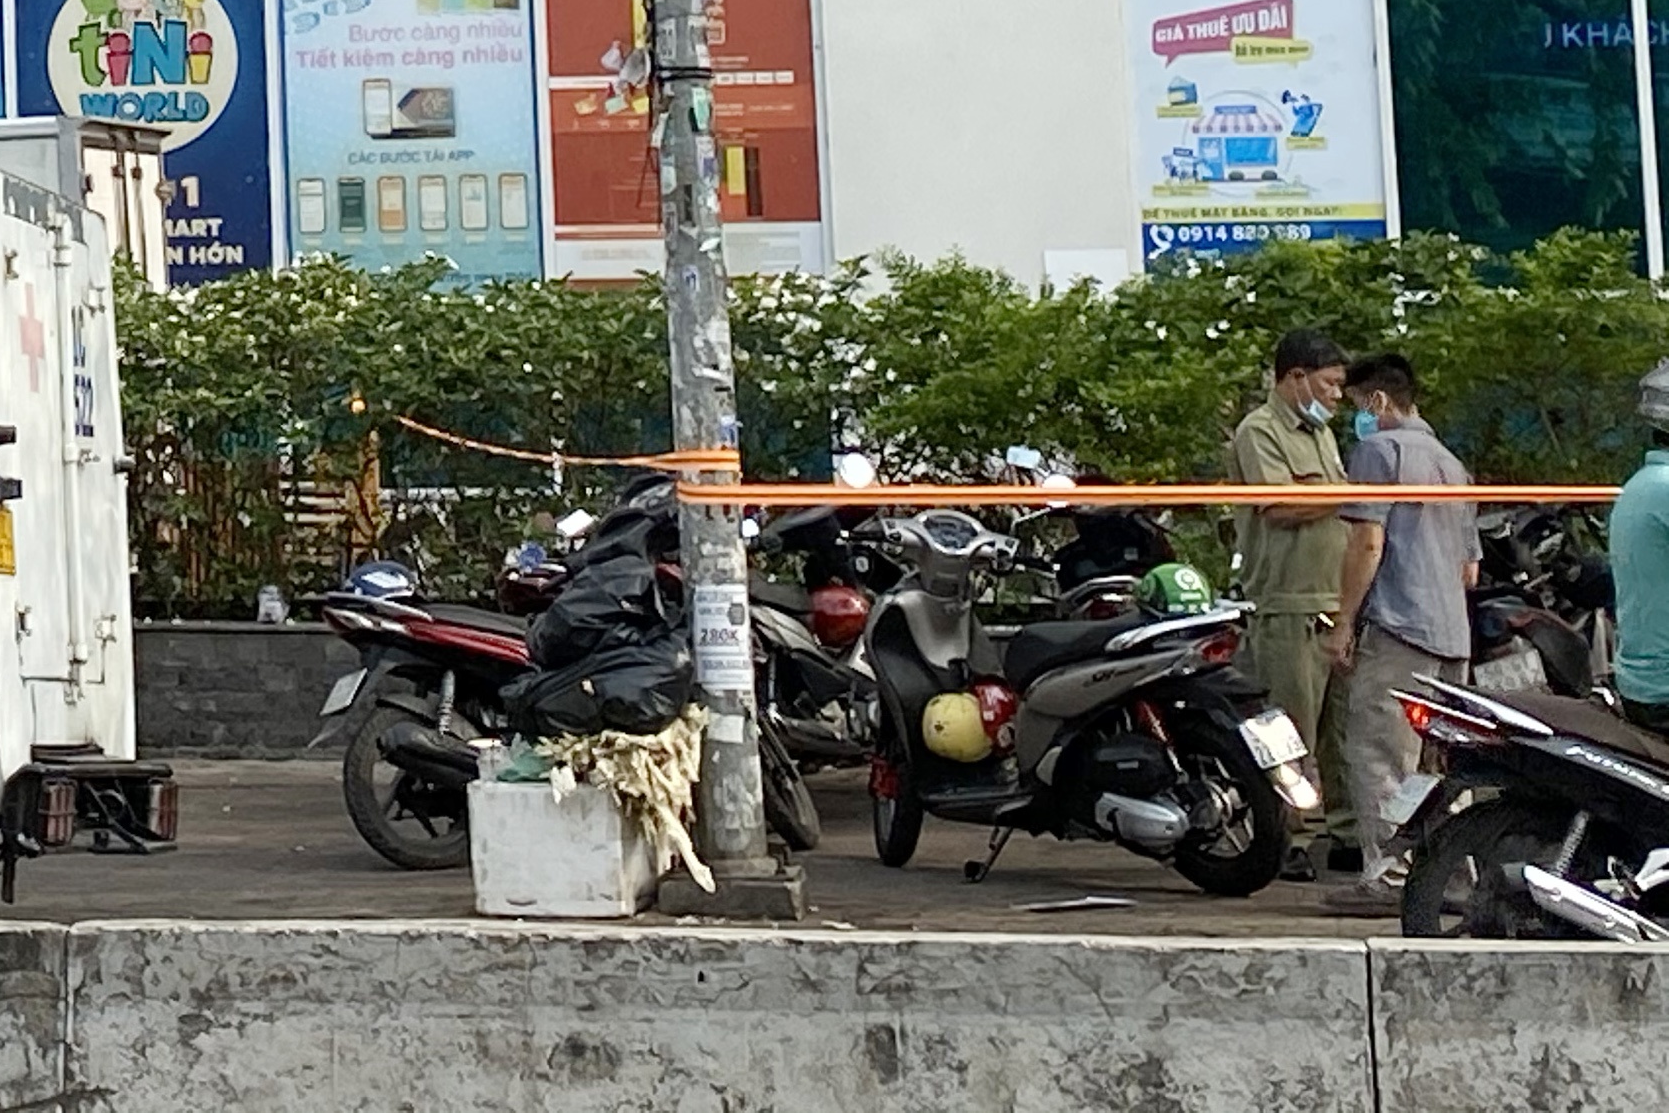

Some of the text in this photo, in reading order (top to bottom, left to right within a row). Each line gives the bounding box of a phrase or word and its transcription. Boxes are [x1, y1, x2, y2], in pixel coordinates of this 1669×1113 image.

[348, 22, 406, 44] Bước
[411, 21, 461, 44] càng
[1154, 25, 1184, 43] GIÁ
[1186, 16, 1229, 40] THUÊ
[1232, 12, 1256, 35] ƯU
[296, 46, 337, 70] Tiết
[79, 91, 211, 123] WORLD
[1178, 223, 1228, 243] 0914
